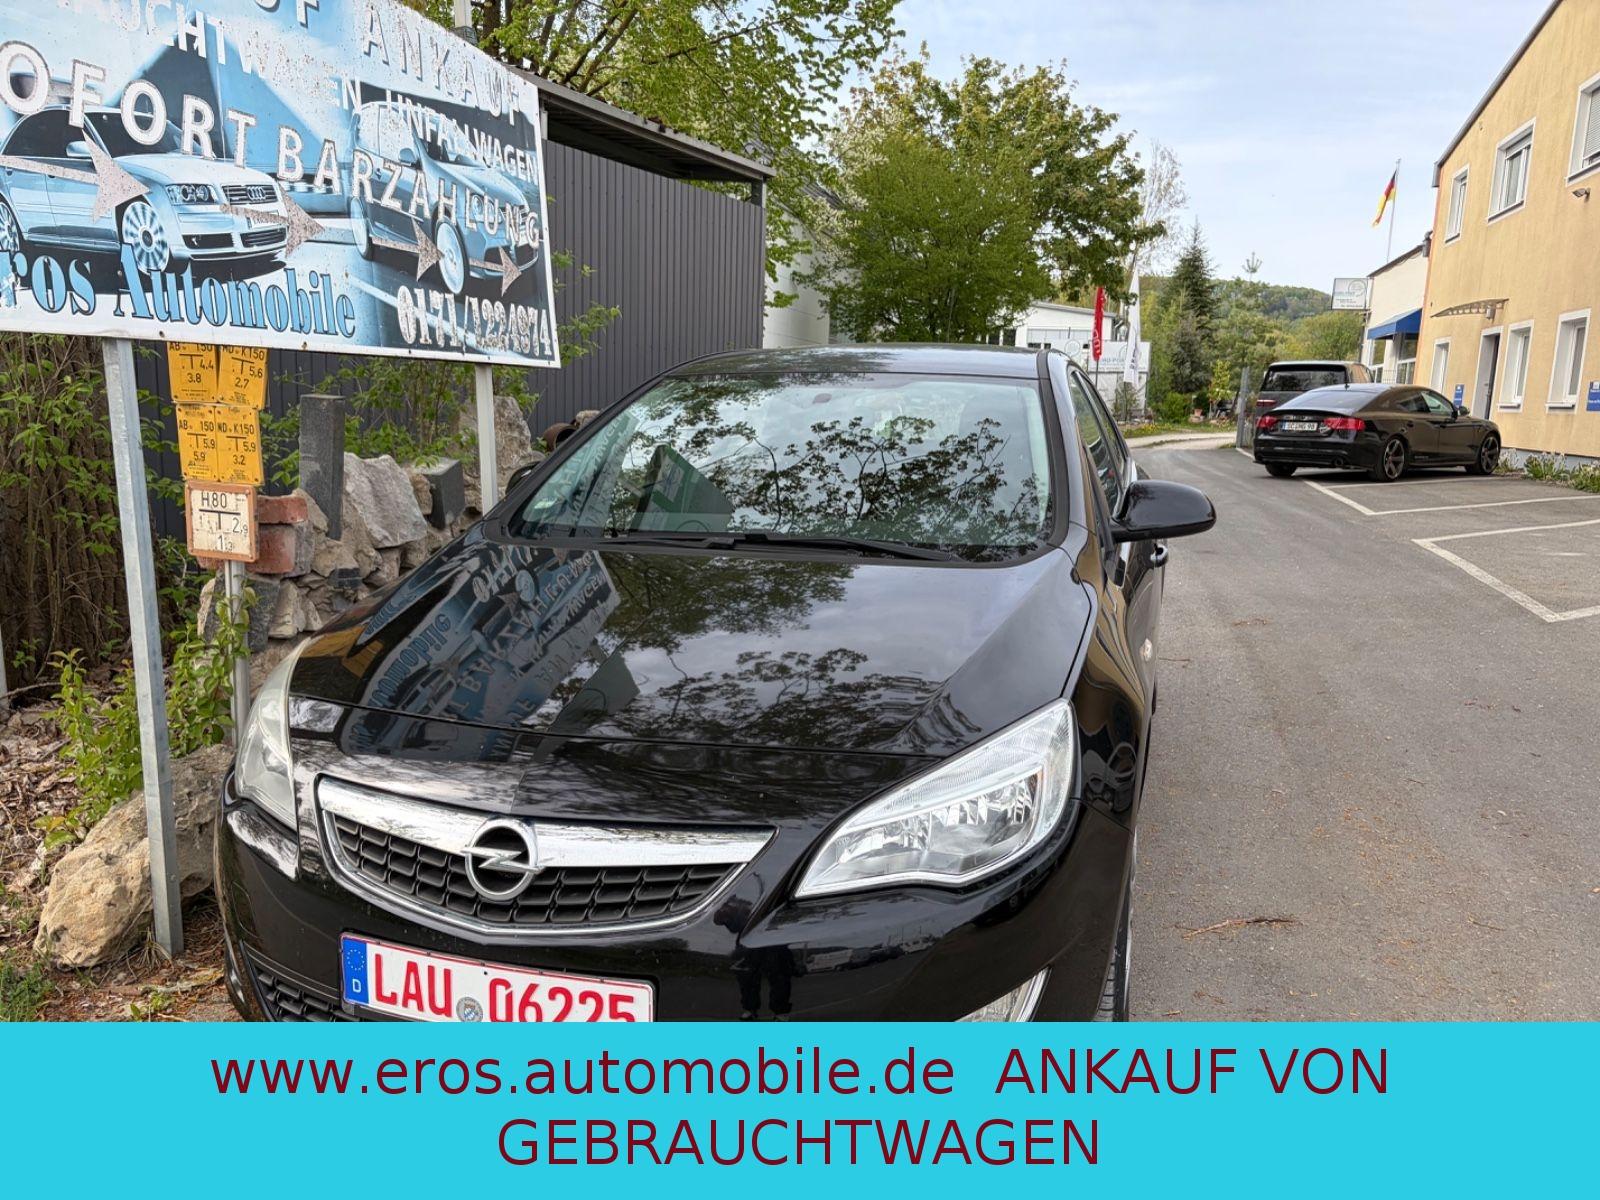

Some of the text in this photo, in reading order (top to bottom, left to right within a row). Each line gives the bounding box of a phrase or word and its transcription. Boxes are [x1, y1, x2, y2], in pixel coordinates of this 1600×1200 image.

[113, 242, 356, 338] Automobile
[200, 420, 215, 432] 150
[201, 492, 228, 509] H80
[352, 979, 362, 993] D
[375, 953, 453, 1018] LAU
